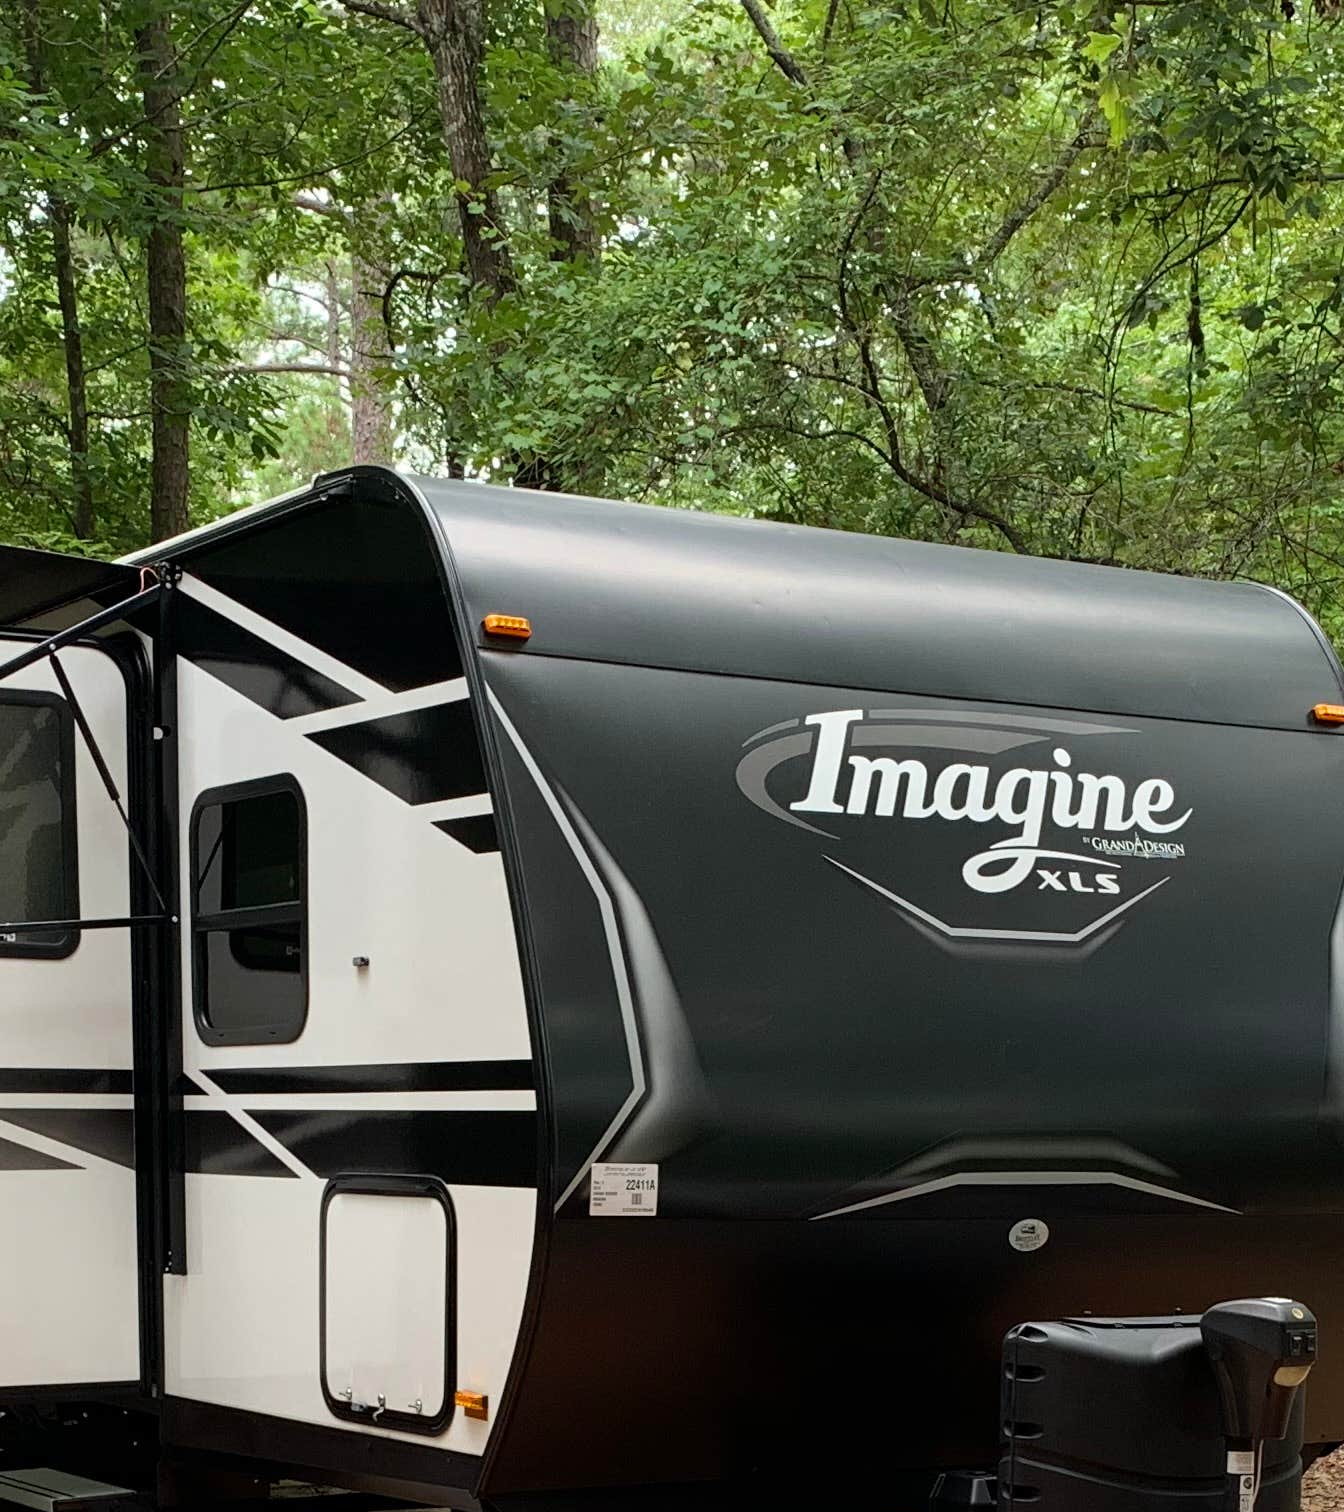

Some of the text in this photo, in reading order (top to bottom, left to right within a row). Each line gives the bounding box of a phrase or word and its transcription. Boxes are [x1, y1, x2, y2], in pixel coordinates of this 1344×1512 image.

[790, 709, 1193, 893] Imagine
[1091, 837, 1135, 853] GRAND
[1143, 840, 1186, 856] DESIGN
[1036, 869, 1121, 894] XLS
